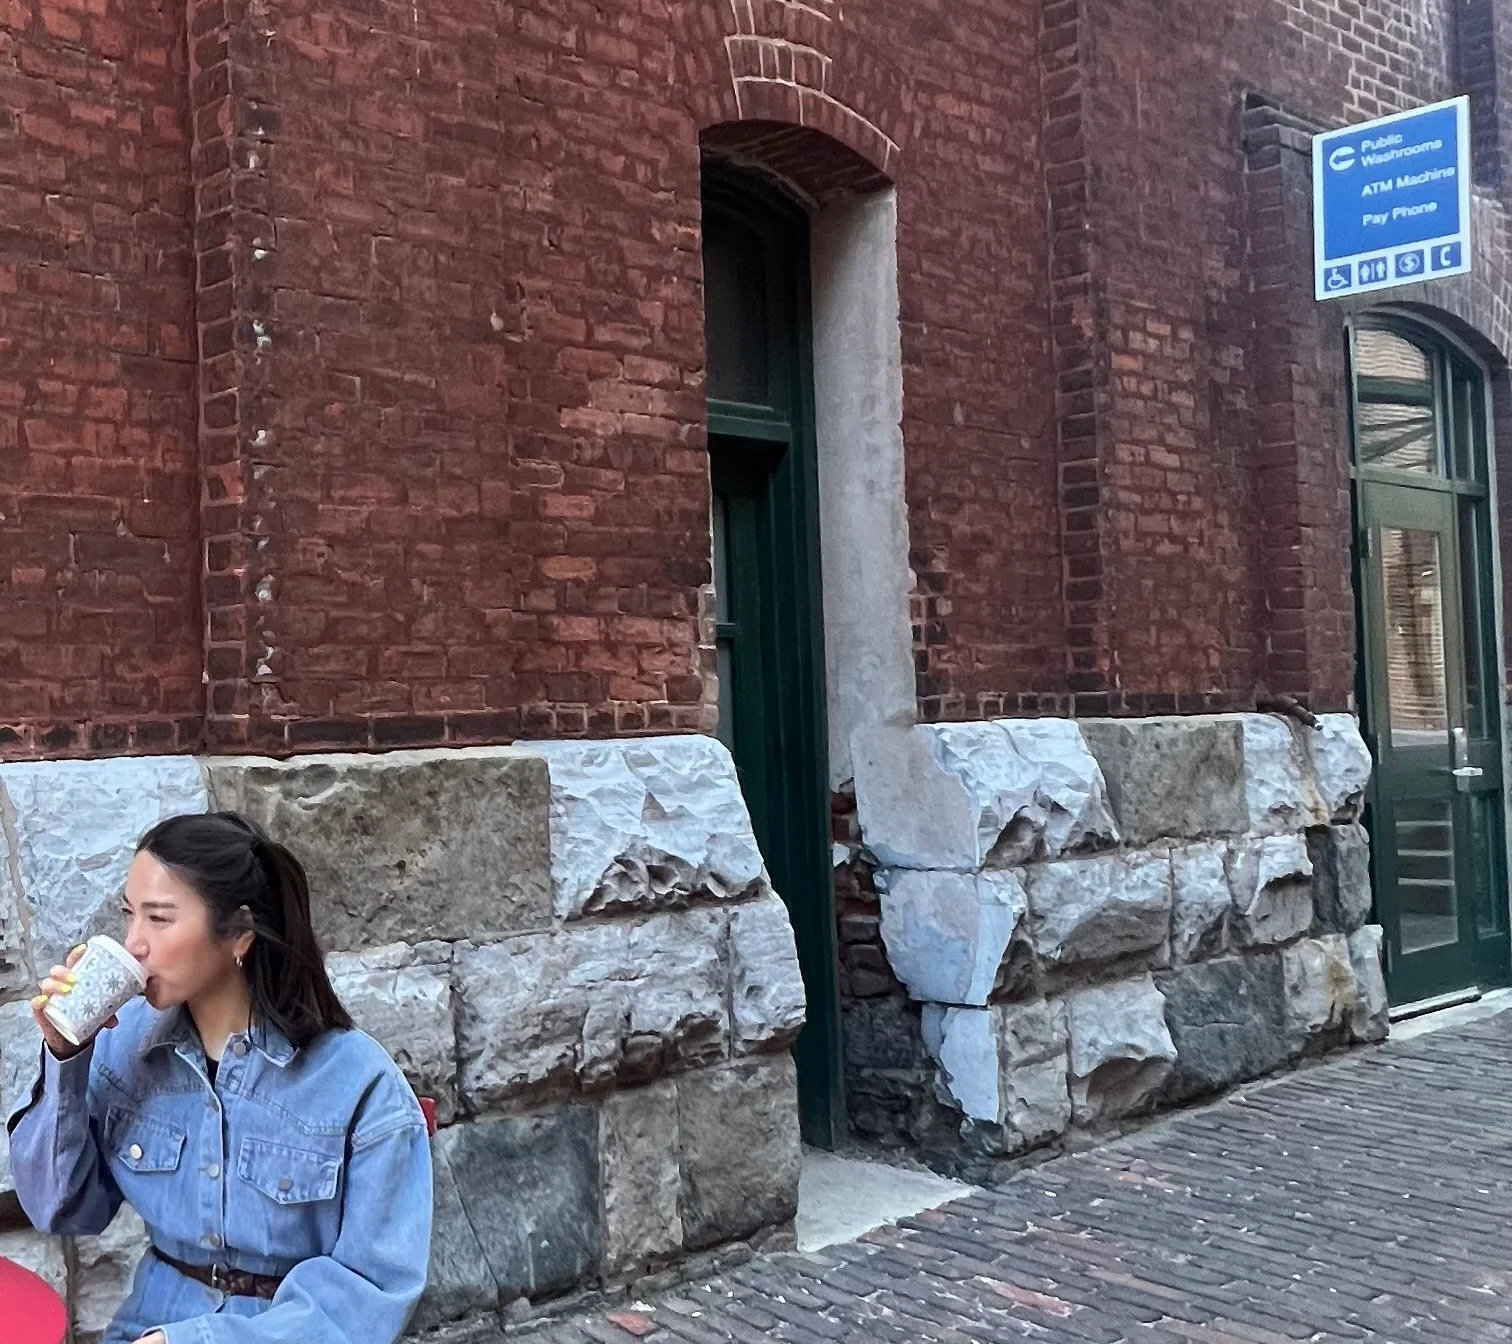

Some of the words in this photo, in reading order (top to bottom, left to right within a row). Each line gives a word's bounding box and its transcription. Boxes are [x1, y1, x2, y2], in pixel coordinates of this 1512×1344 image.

[1360, 133, 1403, 153] Public
[1360, 139, 1443, 167] Washrooms
[1361, 179, 1393, 197] ATM
[1396, 166, 1455, 189] Machine
[1362, 211, 1389, 227] Pay
[1392, 201, 1438, 220] Phone
